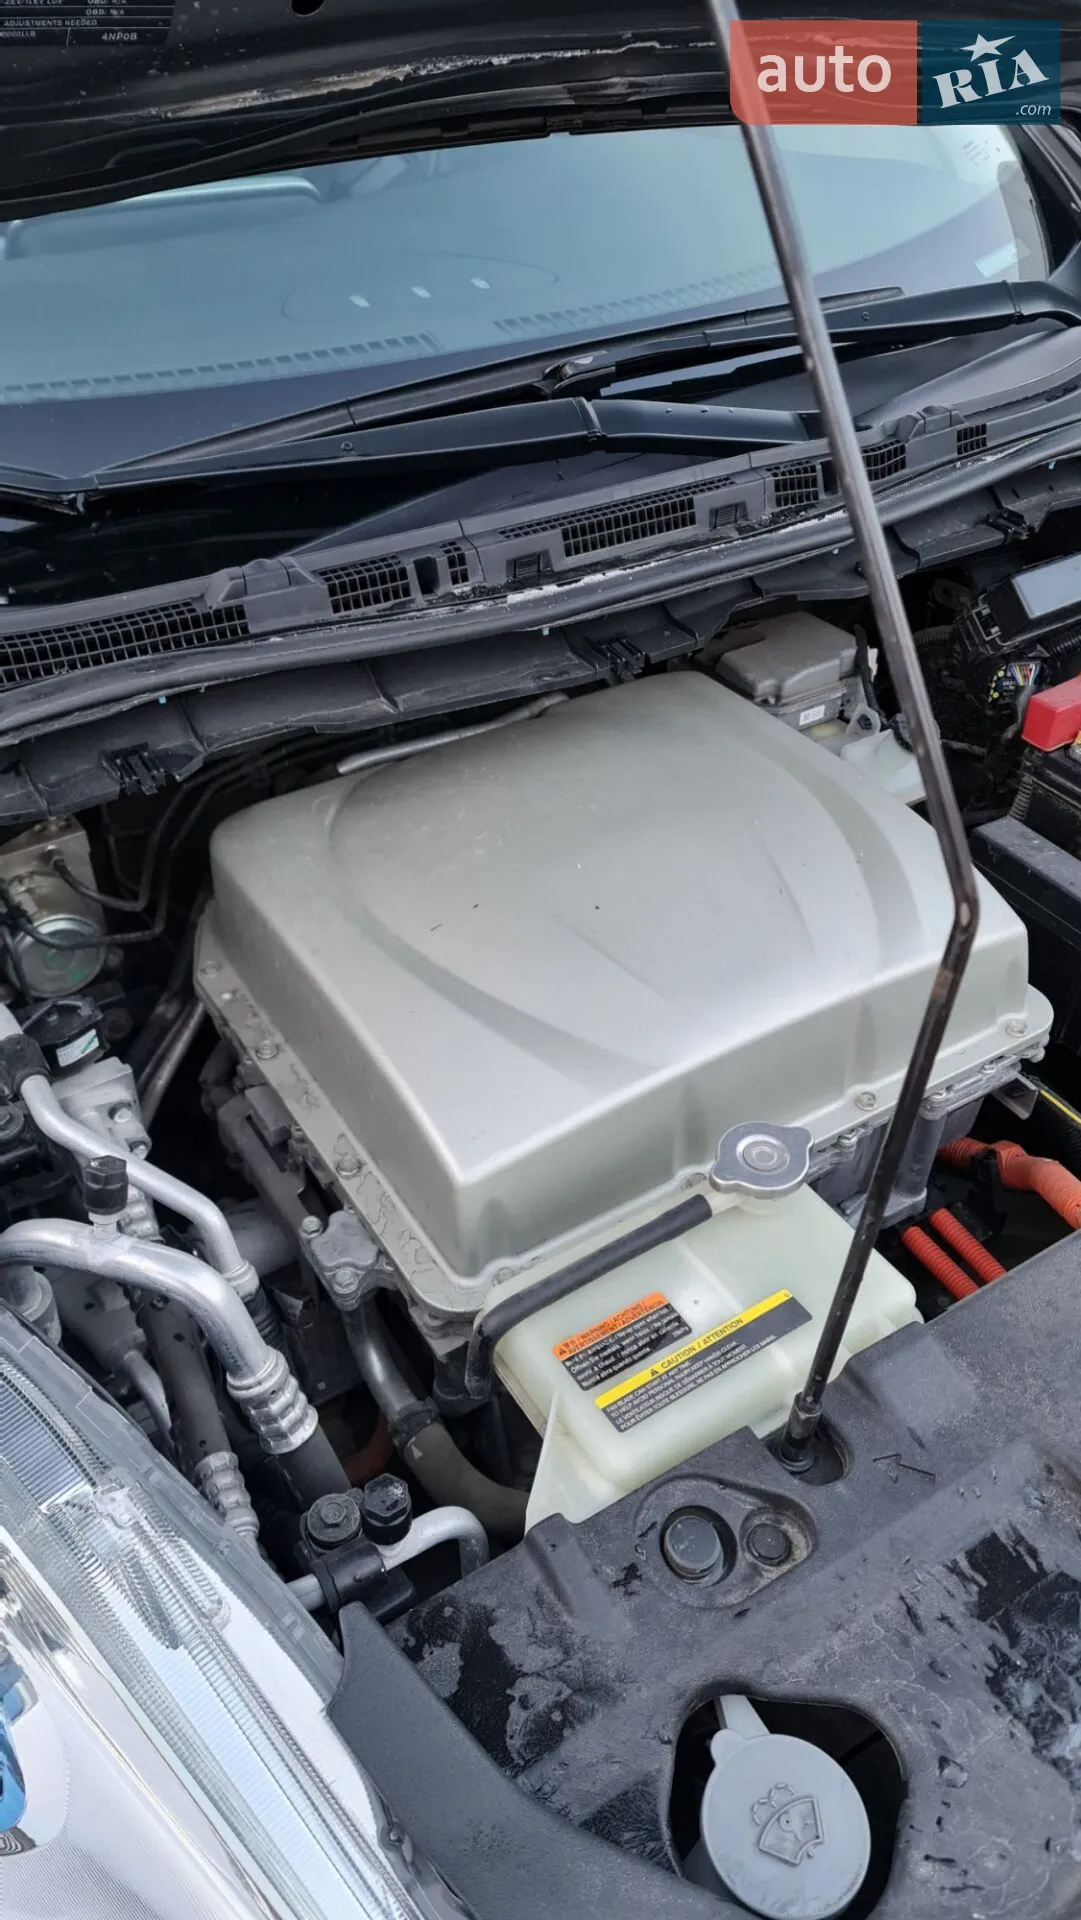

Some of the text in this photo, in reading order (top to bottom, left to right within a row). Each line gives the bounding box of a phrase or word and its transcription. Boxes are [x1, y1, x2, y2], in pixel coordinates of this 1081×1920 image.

[4, 19, 63, 27] ADJUSTMENTS
[659, 1345, 697, 1369] CAUTION
[701, 1317, 744, 1345] ATTENTION
